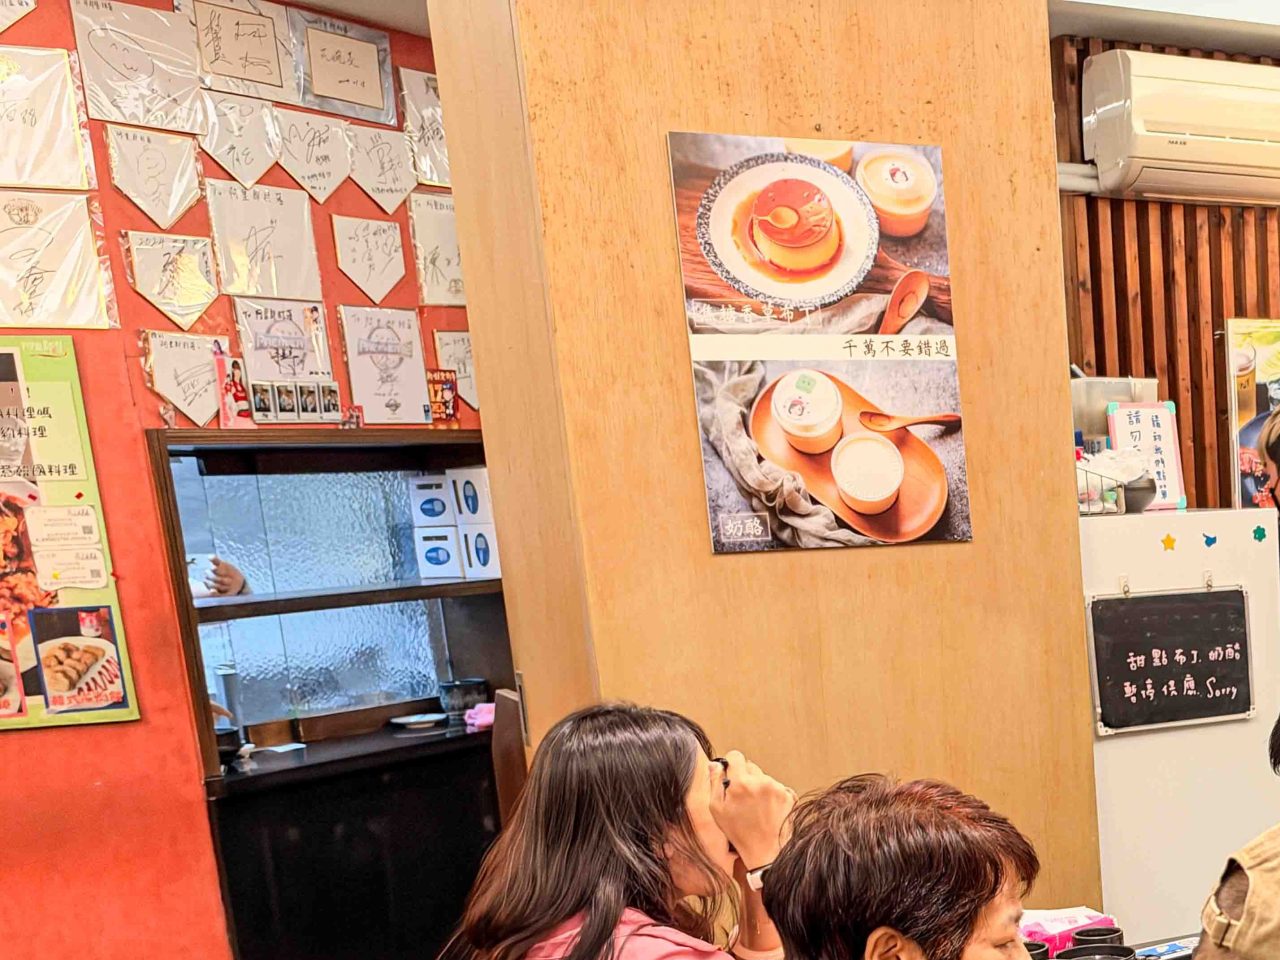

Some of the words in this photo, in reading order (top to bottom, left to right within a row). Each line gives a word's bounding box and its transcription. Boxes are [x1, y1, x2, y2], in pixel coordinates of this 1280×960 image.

[842, 338, 951, 358] 千萬不要錯過
[1126, 410, 1142, 452] 請勿
[724, 516, 764, 537] 奶酪
[1206, 676, 1238, 700] Sorry
